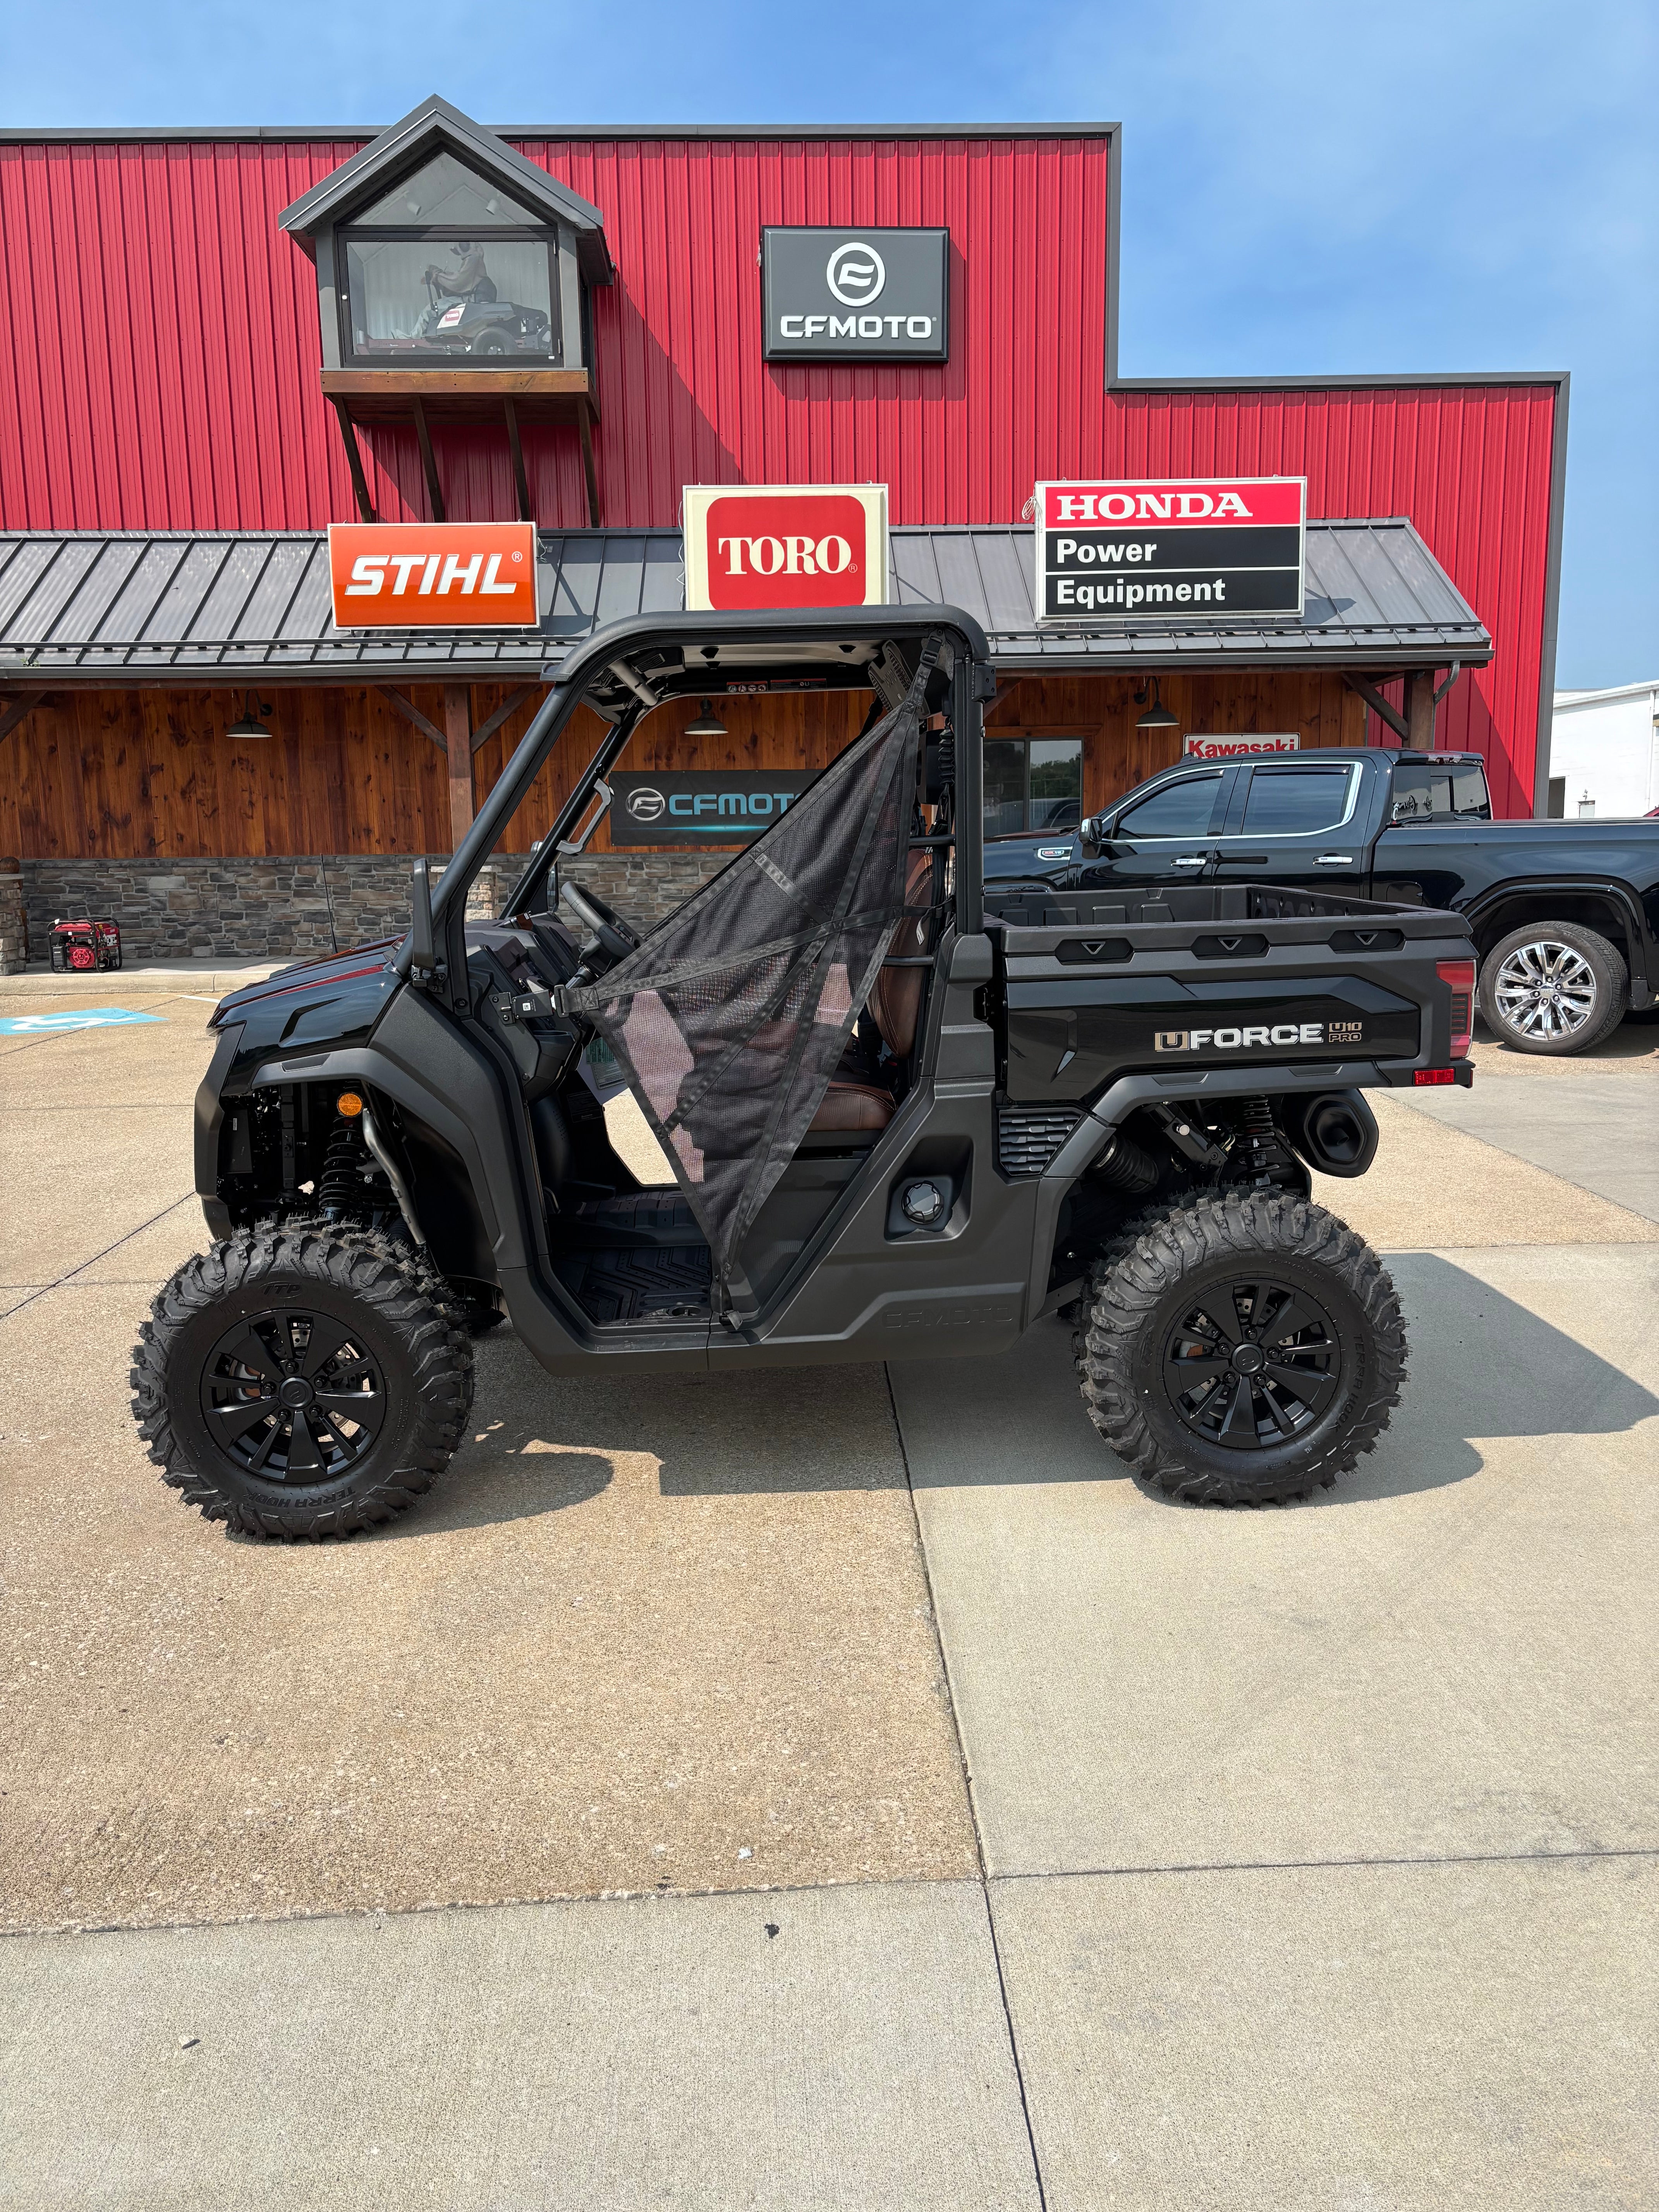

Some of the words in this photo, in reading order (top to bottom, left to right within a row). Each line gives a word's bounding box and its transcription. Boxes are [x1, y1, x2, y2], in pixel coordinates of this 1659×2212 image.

[780, 316, 932, 338] CFMOTO
[1056, 493, 1253, 520] HONDA
[718, 535, 852, 575] TORO
[1056, 539, 1157, 563] Power
[344, 553, 517, 596] STIHL
[1056, 579, 1226, 609] Equipment
[669, 793, 802, 815] CFMOT
[1154, 1023, 1324, 1052] UFORCE
[1329, 1022, 1362, 1032] U10
[1329, 1032, 1362, 1042] PRO
[264, 1282, 302, 1295] ITP
[295, 1486, 356, 1508] TERRA
